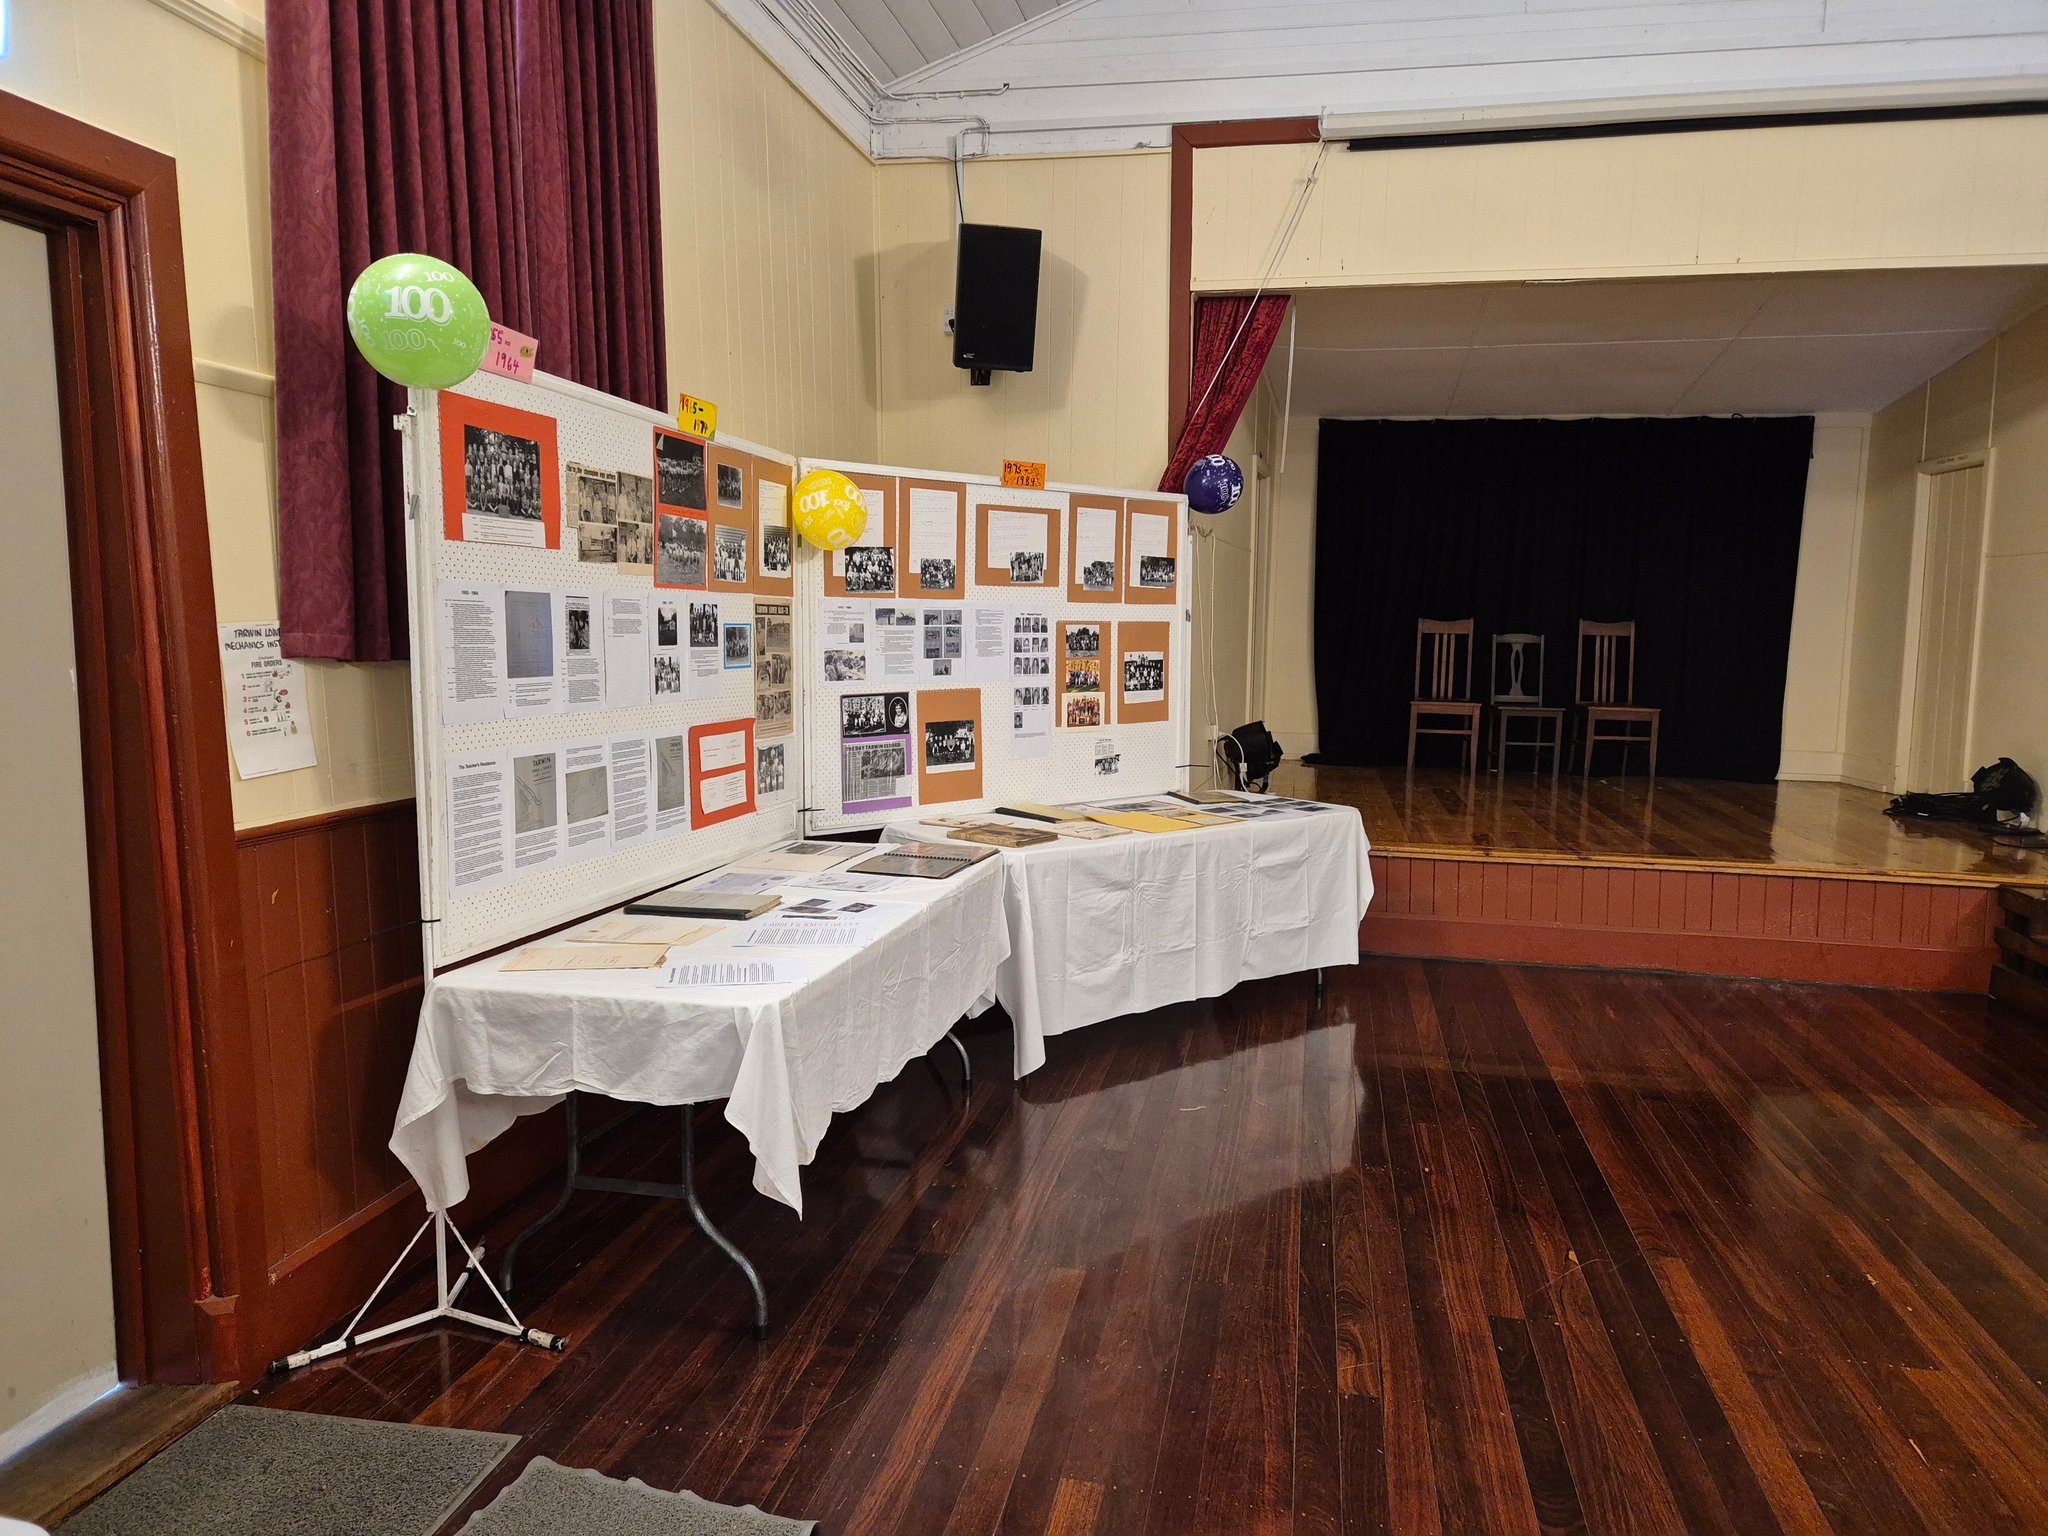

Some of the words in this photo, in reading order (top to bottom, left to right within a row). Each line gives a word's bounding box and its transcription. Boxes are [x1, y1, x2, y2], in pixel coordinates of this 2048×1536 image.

[424, 271, 455, 282] 100
[384, 285, 453, 326] 100
[382, 329, 427, 351] 100
[452, 338, 466, 349] 100
[496, 351, 520, 375] 1964
[1016, 475, 1036, 487] 1984
[800, 489, 830, 513] 100
[833, 499, 851, 511] 100
[234, 628, 262, 638] TARWIN
[225, 640, 265, 651] MECHANICS
[263, 660, 283, 668] ORDERS
